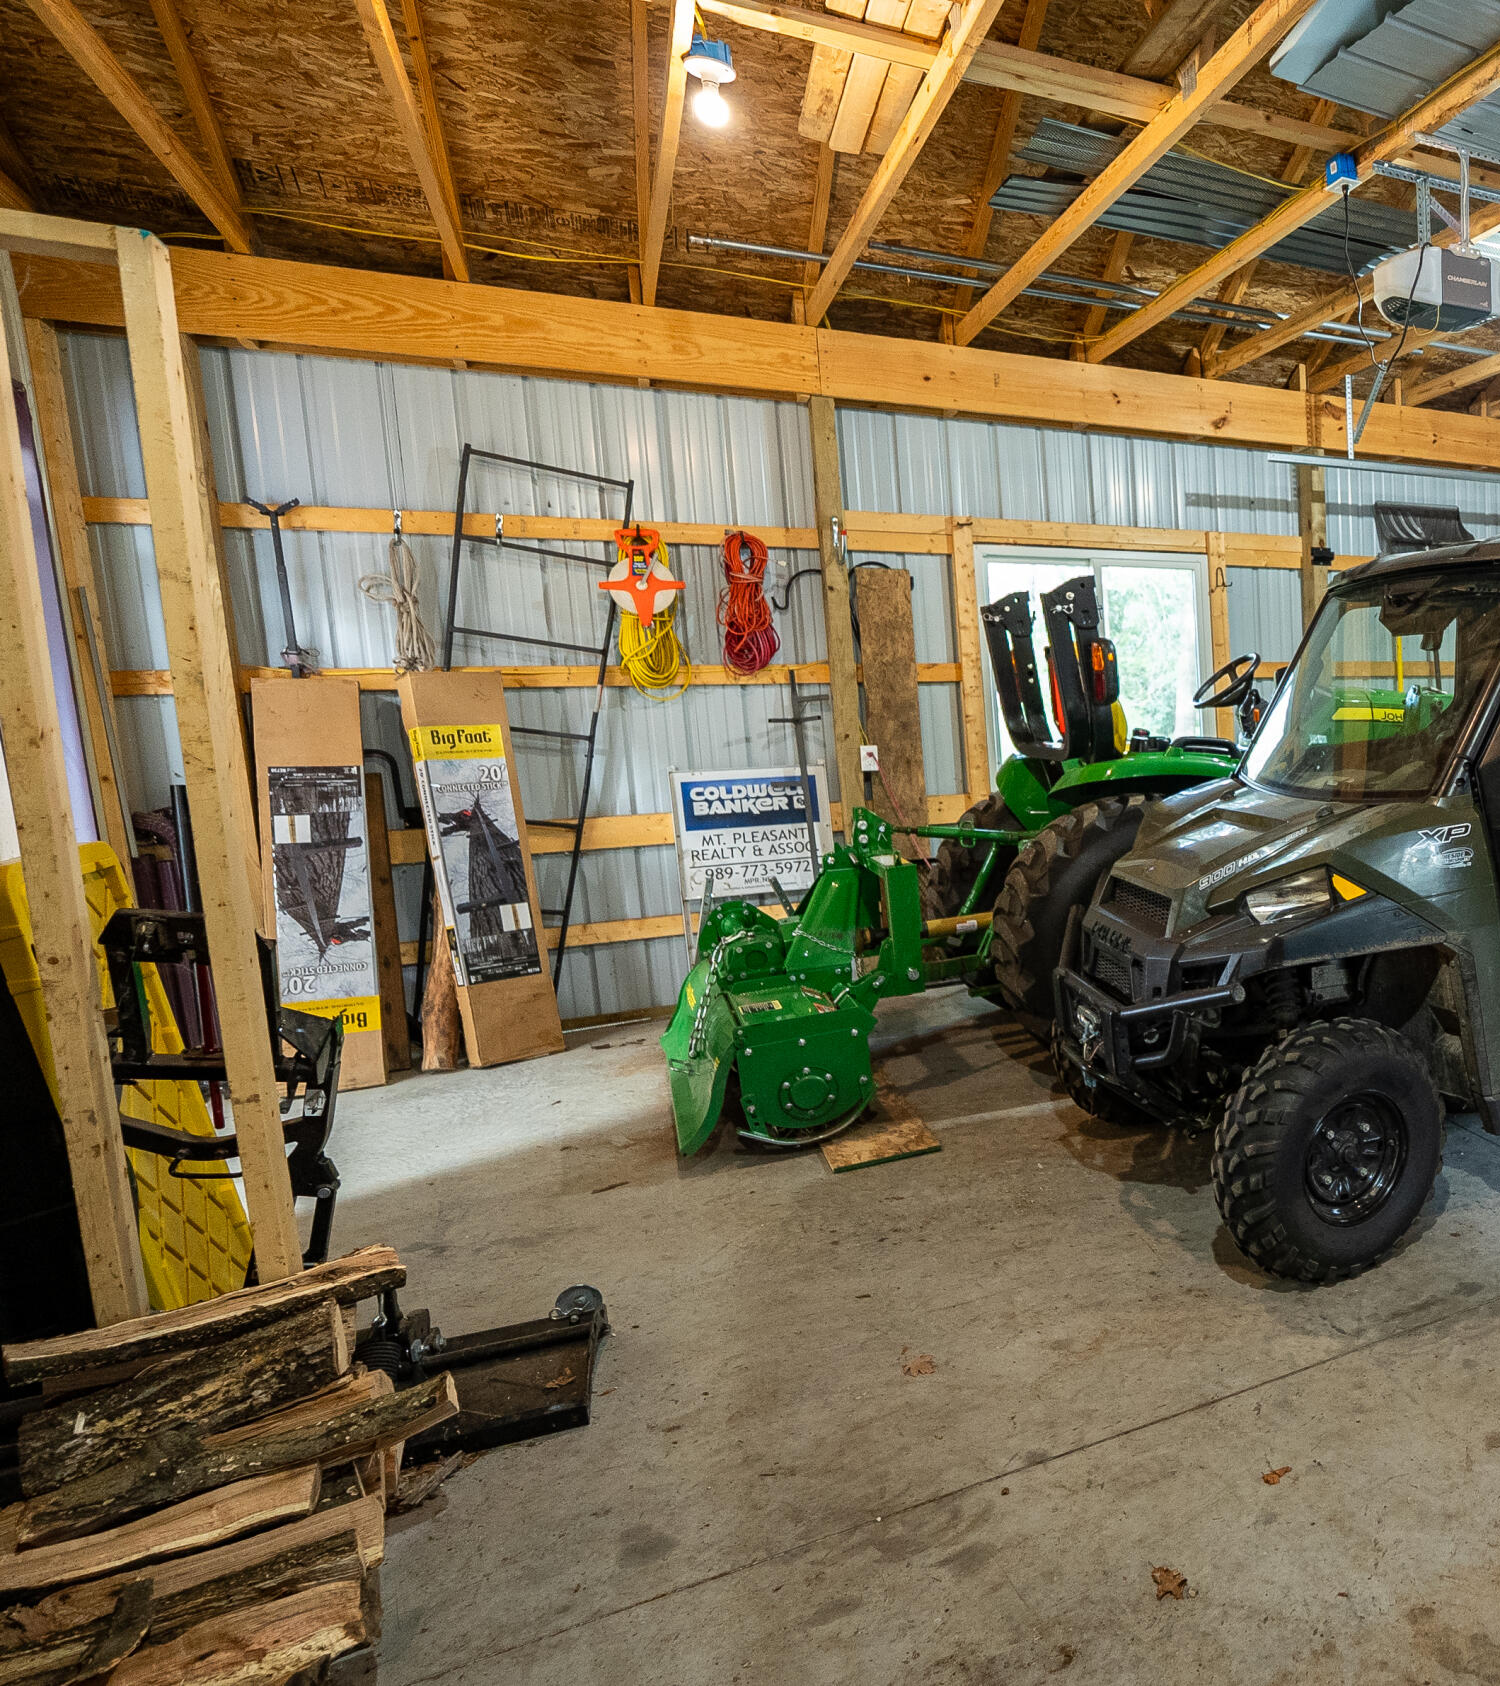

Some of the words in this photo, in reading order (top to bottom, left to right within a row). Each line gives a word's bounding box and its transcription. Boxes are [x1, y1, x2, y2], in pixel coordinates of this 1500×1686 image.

[1381, 711, 1403, 721] JOH
[437, 783, 480, 794] CONNECTED
[702, 833, 726, 847] MT.
[733, 827, 807, 844] PLEASANT
[1410, 822, 1472, 850] XP
[691, 846, 747, 862] REALTY
[753, 845, 763, 857] &
[705, 860, 812, 881] 989-773-5972
[1199, 861, 1236, 891] 900
[317, 961, 368, 975] CONNECTED
